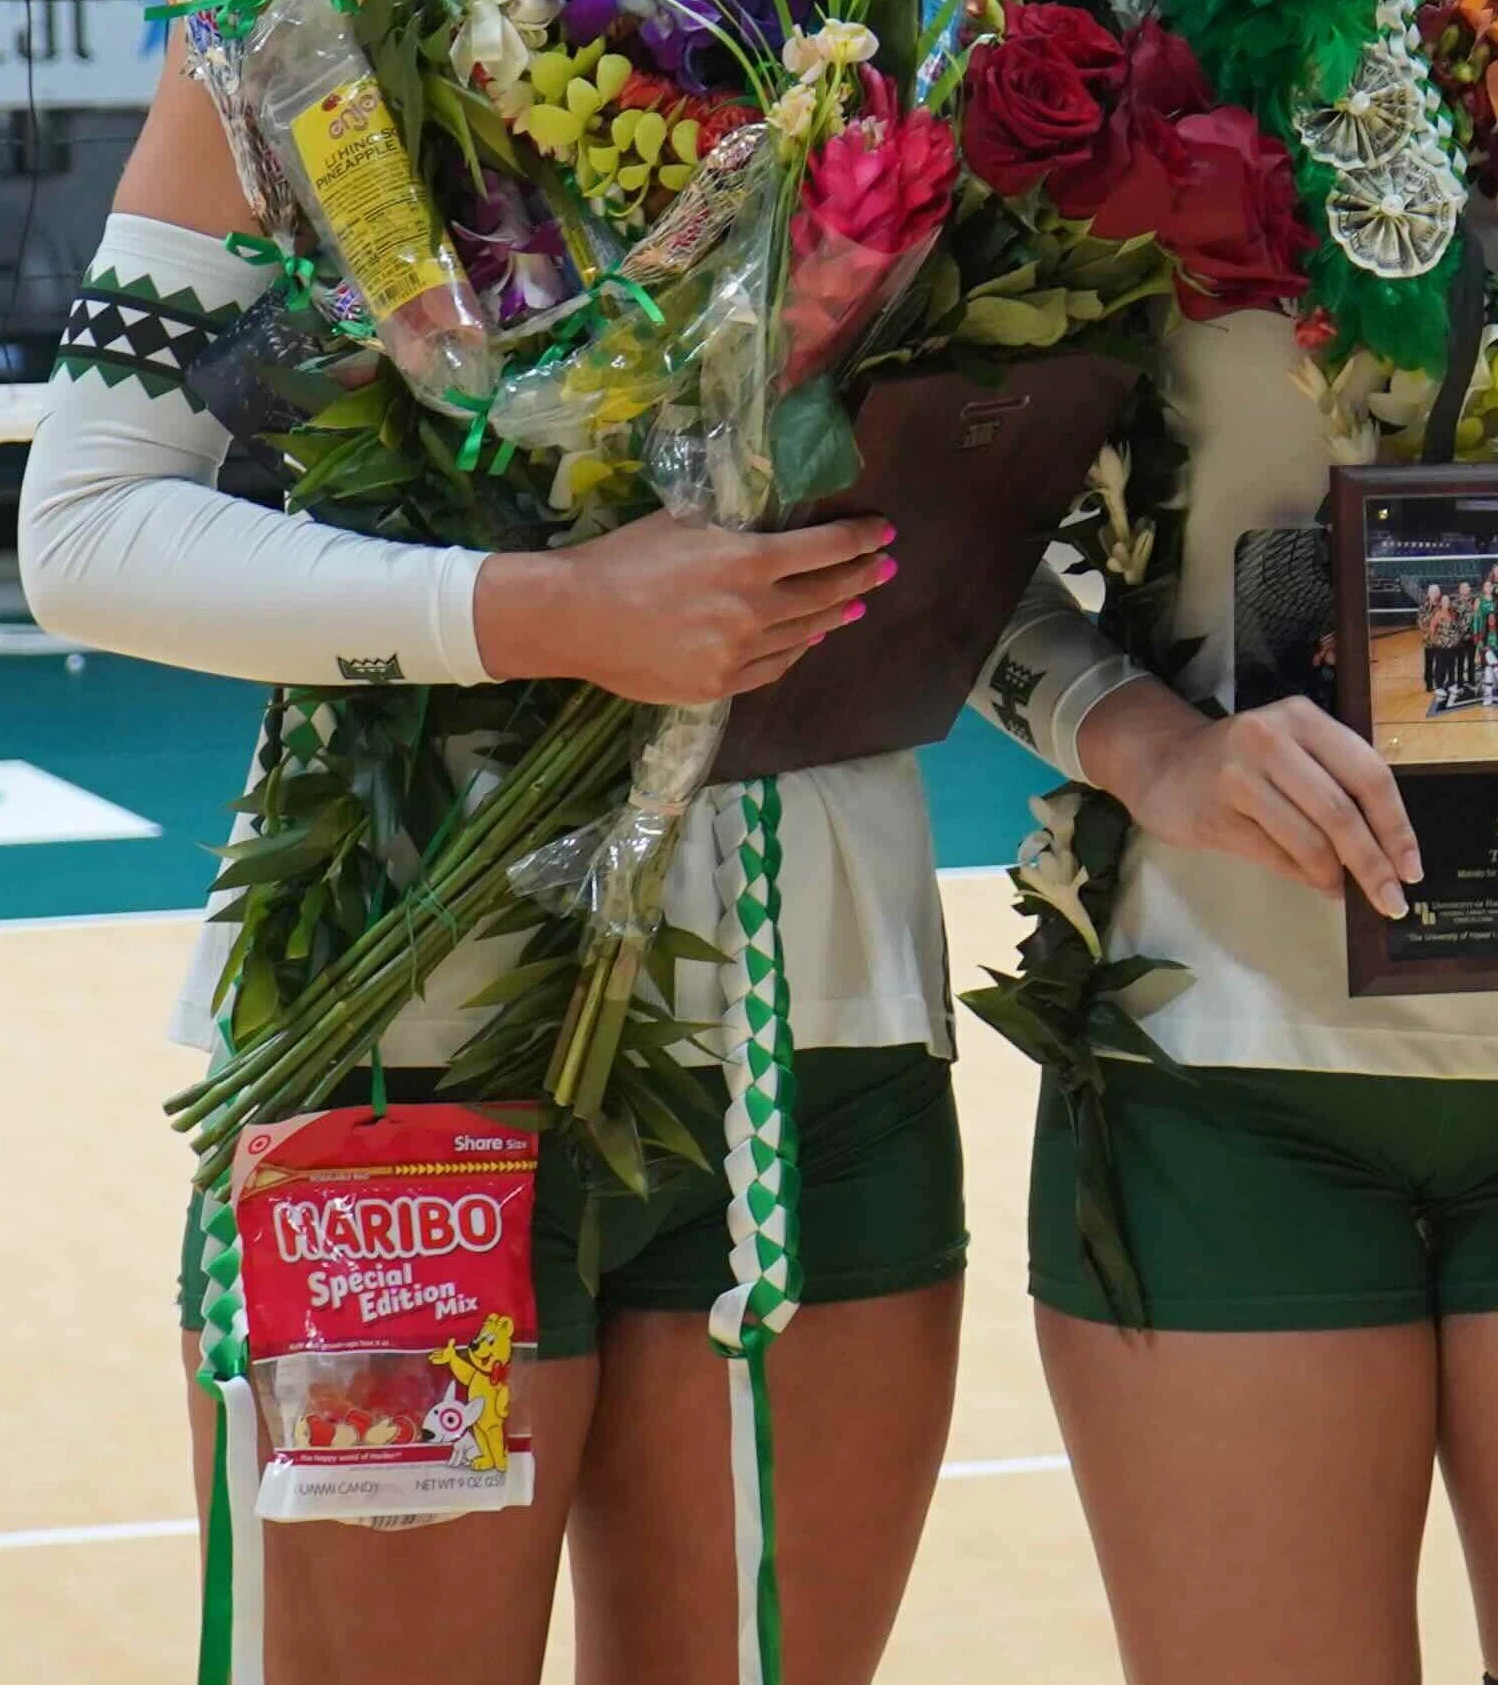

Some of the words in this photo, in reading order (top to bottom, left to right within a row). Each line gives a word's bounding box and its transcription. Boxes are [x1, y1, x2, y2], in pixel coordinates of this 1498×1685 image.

[315, 141, 398, 190] PINEAPPLE
[454, 1134, 503, 1153] Share
[273, 1193, 503, 1262] HARIBO
[306, 1261, 414, 1308] Special
[359, 1281, 457, 1324] Edition
[433, 1293, 480, 1321] Mix
